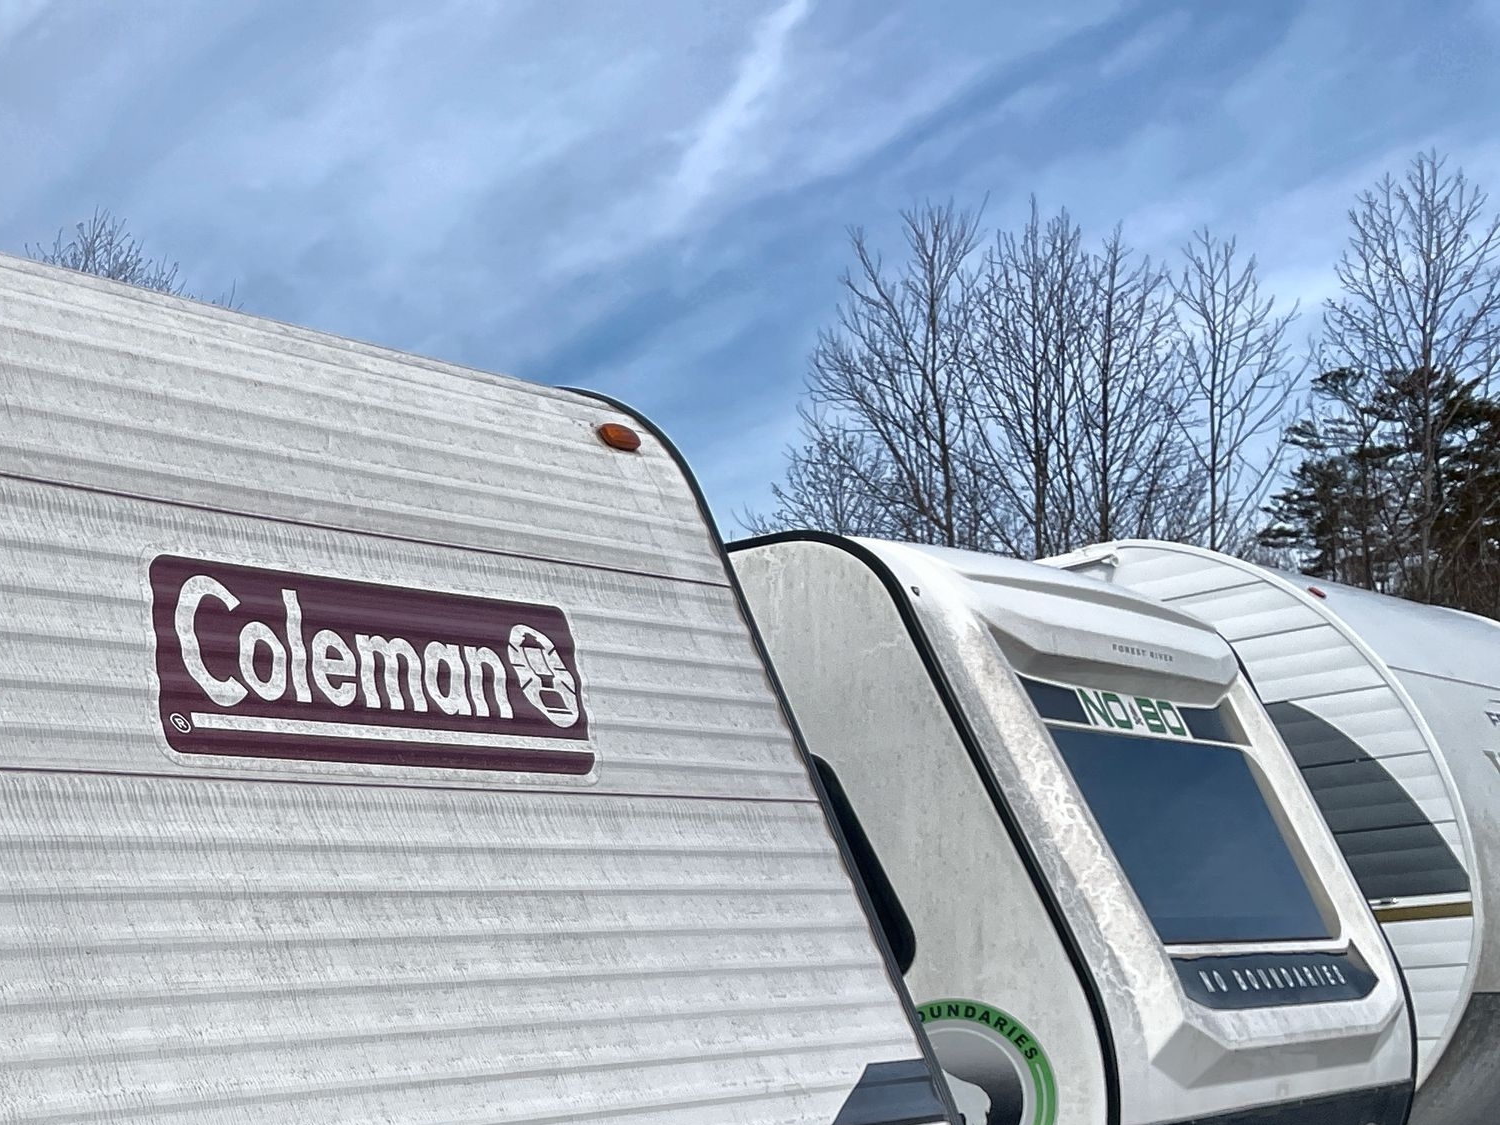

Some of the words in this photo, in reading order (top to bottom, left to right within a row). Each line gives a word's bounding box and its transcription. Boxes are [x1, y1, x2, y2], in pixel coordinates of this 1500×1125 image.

[174, 575, 514, 719] Coleman
[1111, 643, 1146, 657] FOREST
[1149, 651, 1174, 662] RIVER
[1199, 970, 1228, 993] NO
[1232, 964, 1346, 991] BOUNDARIES
